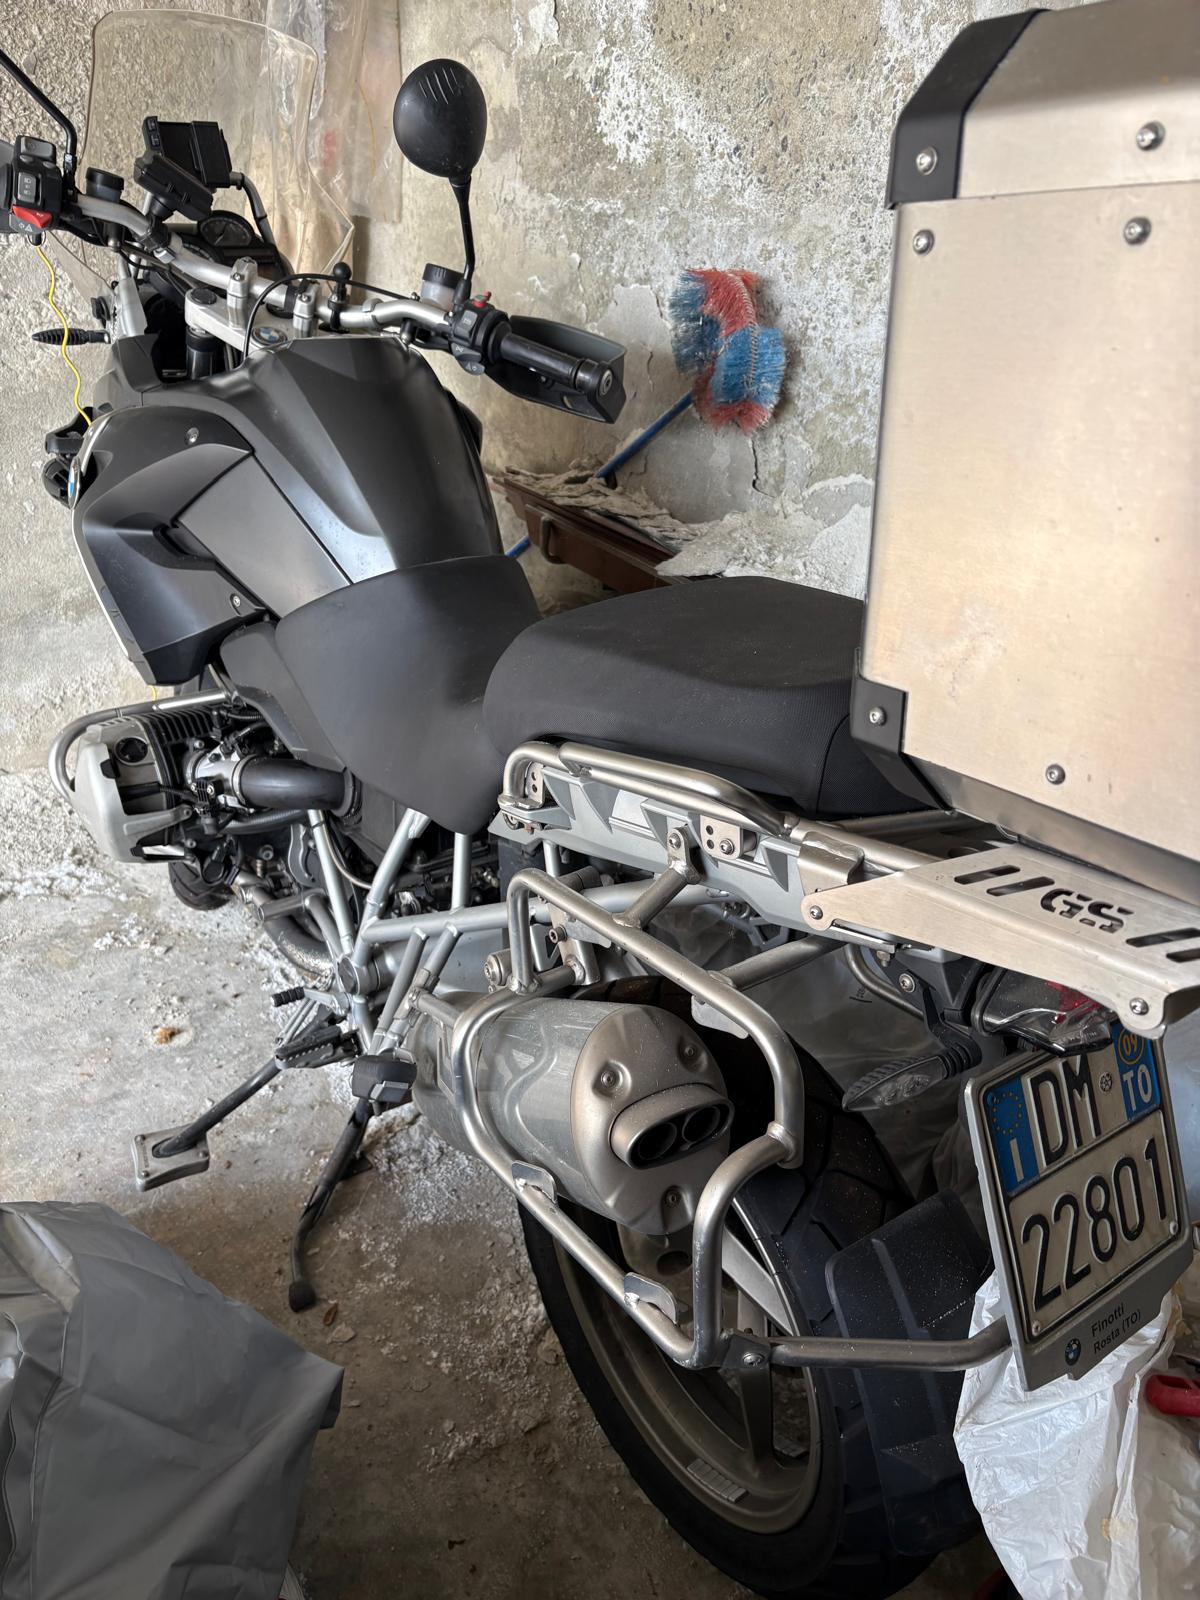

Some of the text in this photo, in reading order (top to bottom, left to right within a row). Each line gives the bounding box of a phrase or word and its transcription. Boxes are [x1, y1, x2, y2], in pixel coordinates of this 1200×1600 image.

[1040, 888, 1134, 934] GS
[1123, 1064, 1152, 1111] TO
[1029, 1054, 1101, 1168] DM
[1021, 1138, 1167, 1313] 22801
[1091, 1302, 1125, 1337] Finotti
[1093, 1328, 1121, 1354] Rosta
[1121, 1308, 1142, 1334] (TO)
